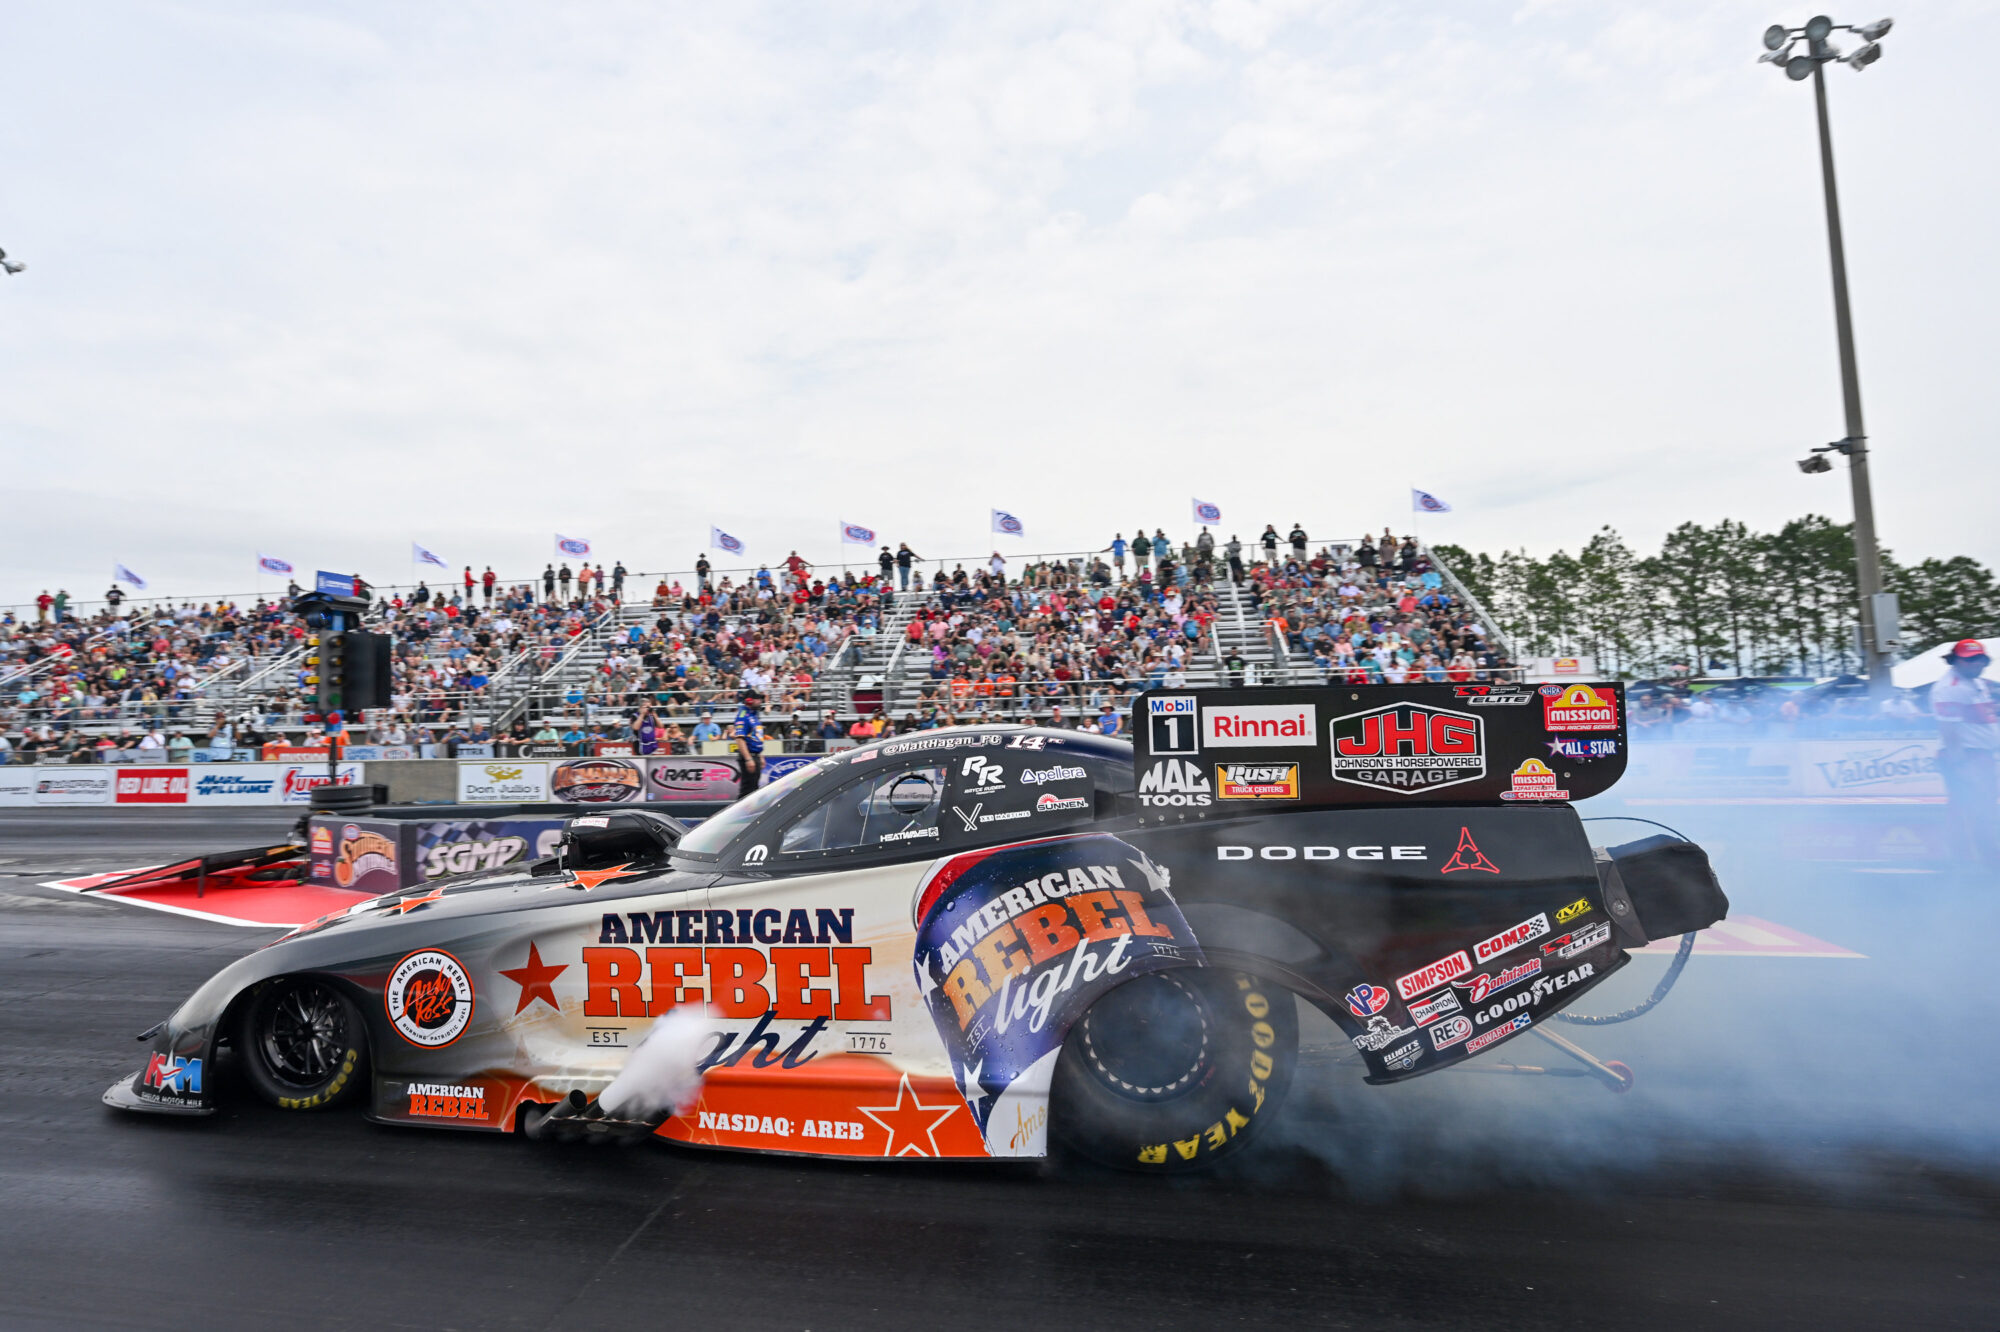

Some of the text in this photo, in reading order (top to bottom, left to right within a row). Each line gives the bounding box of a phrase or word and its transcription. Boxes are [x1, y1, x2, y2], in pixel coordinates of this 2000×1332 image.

[1540, 687, 1563, 695] NHRA
[1151, 700, 1193, 713] Mobil
[1164, 717, 1178, 749] 1
[1214, 713, 1305, 737] Rinnai
[1337, 710, 1477, 757] JHG
[882, 735, 1001, 756] @MattHagan_FC
[1006, 735, 1047, 752] 14
[1566, 741, 1616, 754] ALL STAR
[1335, 757, 1481, 768] JOHNSON'S HORSEPOWERED
[118, 778, 142, 793] RED
[1139, 759, 1211, 793] MAC
[1226, 765, 1290, 786] RUSH
[1357, 770, 1459, 786] GARAGE
[196, 785, 272, 796] WILLIAMS
[466, 785, 494, 794] Don
[1038, 800, 1084, 812] SUNNEN
[1139, 795, 1212, 806] TOOLS
[880, 828, 928, 842] HEATWAVE
[426, 839, 525, 876] SGMP
[1217, 846, 1427, 860] DODGE
[599, 908, 854, 944] AMERICAN
[939, 866, 1125, 974] AMERICAN
[1478, 924, 1531, 958] COMP
[1517, 929, 1543, 945] CAMS
[1561, 928, 1607, 954] ELITE
[943, 890, 1175, 1032] REBEL
[392, 957, 467, 1010] THE AMERICAN REBEL
[582, 947, 892, 1021] REBEL
[1402, 956, 1466, 996] SIMPSON
[1345, 984, 1373, 1016] VP
[1415, 997, 1455, 1019] CHAMPION
[430, 1025, 459, 1040] PATRIOTIC
[592, 1031, 620, 1044] EST
[970, 1024, 985, 1046] EST
[1468, 1022, 1514, 1052] SCHWARTZ
[851, 1037, 887, 1050] 1776
[1384, 1040, 1420, 1062] ELLIOTT'S
[407, 1083, 485, 1098] AMERICAN
[409, 1096, 489, 1119] REBEL
[698, 1111, 864, 1140] NASDAQ: AREB
